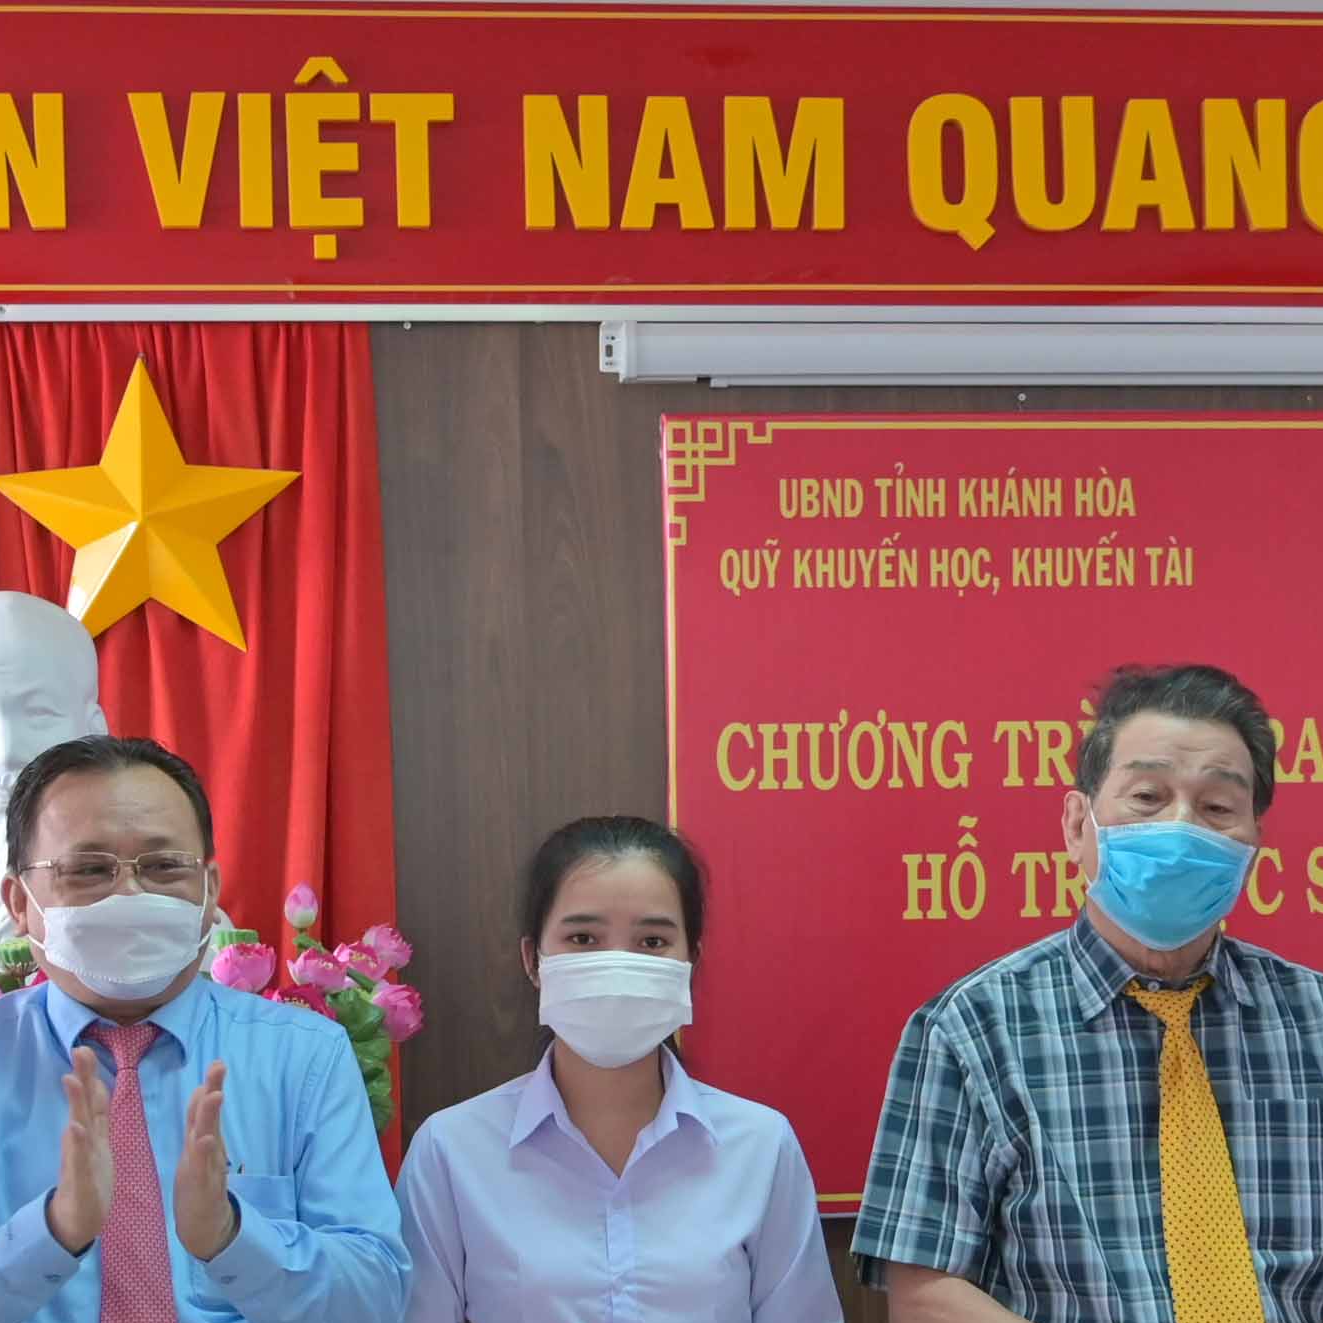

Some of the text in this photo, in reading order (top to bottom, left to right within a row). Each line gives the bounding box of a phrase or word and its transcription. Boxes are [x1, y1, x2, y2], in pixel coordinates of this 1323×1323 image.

[128, 56, 454, 259] VIỆT
[523, 94, 846, 230] NAM
[779, 463, 1137, 518] UBND TỈNH KHÁNH HÒA
[720, 532, 1194, 597] QUỸ KHUYẾN HỌC, KHUYẾN TÀI
[716, 708, 973, 792] CHƯƠNG
[901, 815, 987, 920] HỖ
[1011, 851, 1085, 918] TR
